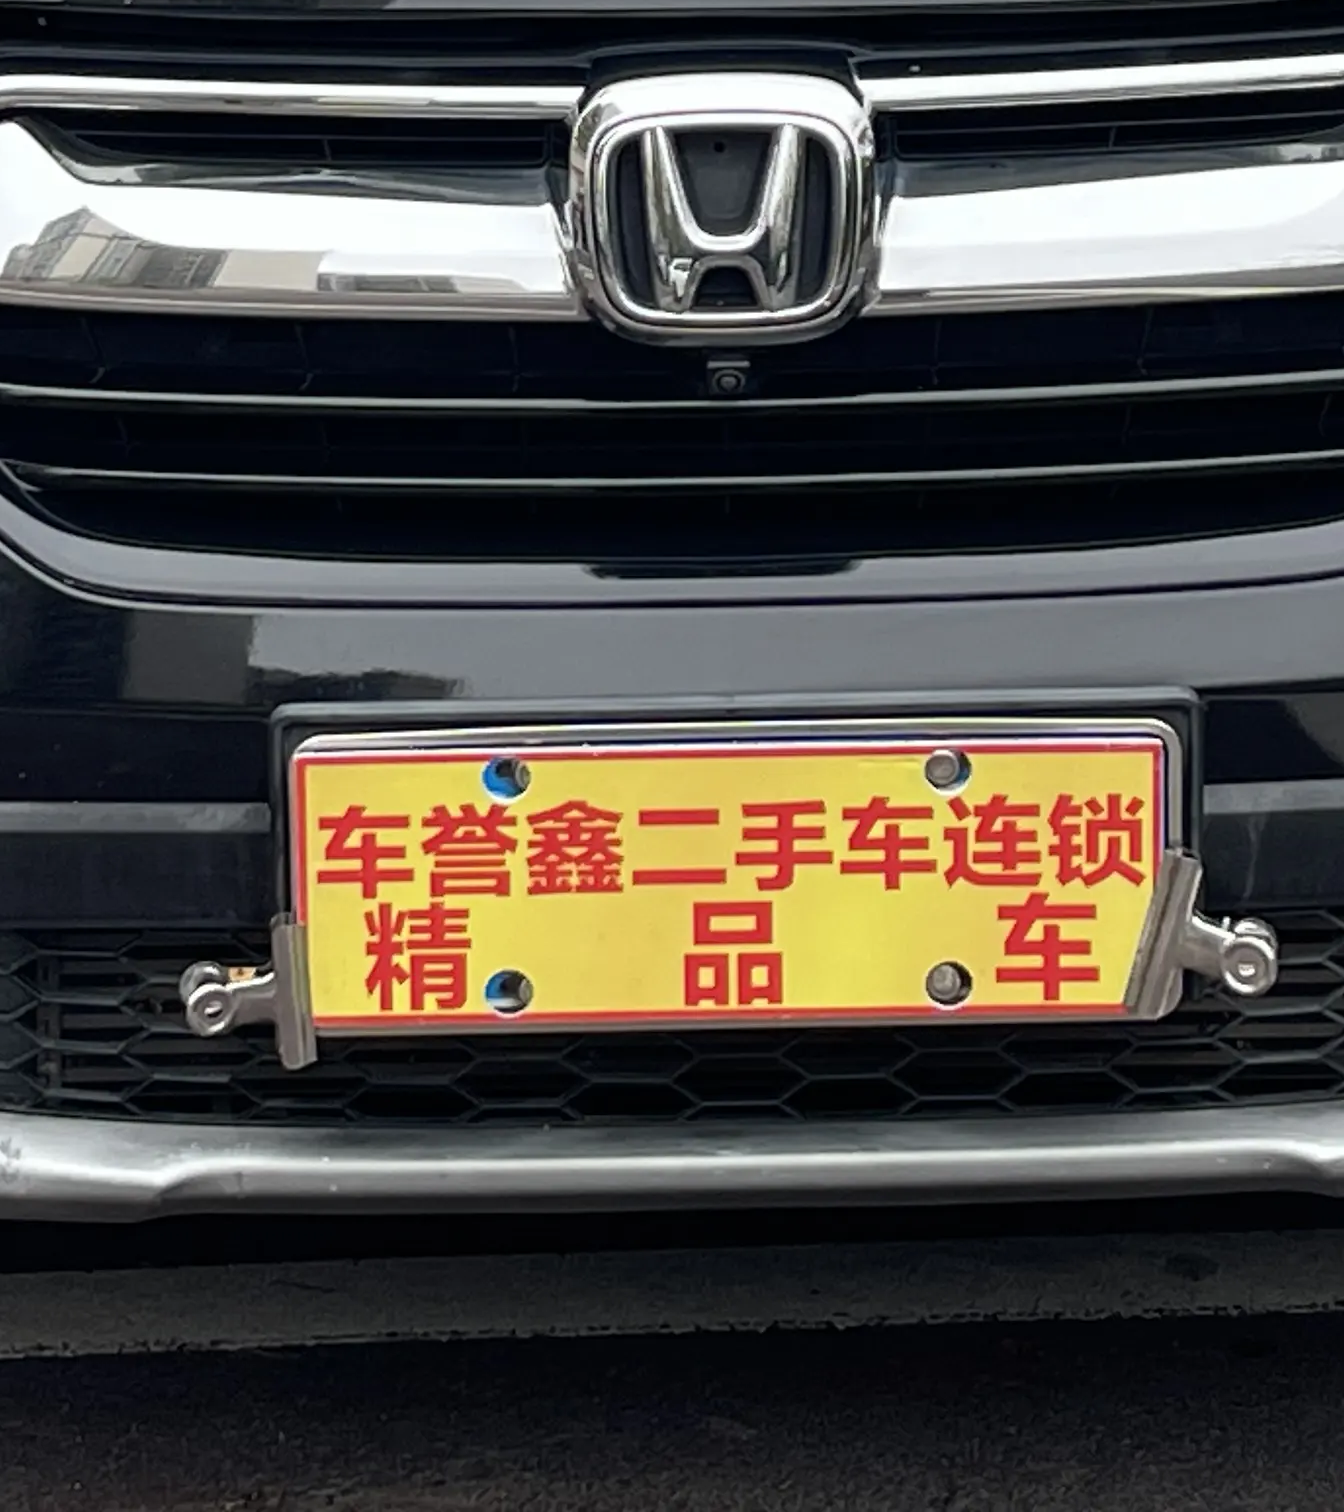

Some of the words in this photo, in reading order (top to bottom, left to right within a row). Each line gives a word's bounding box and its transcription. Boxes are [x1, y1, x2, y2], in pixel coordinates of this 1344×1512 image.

[316, 794, 1143, 899] 车誉鑫二手车连锁
